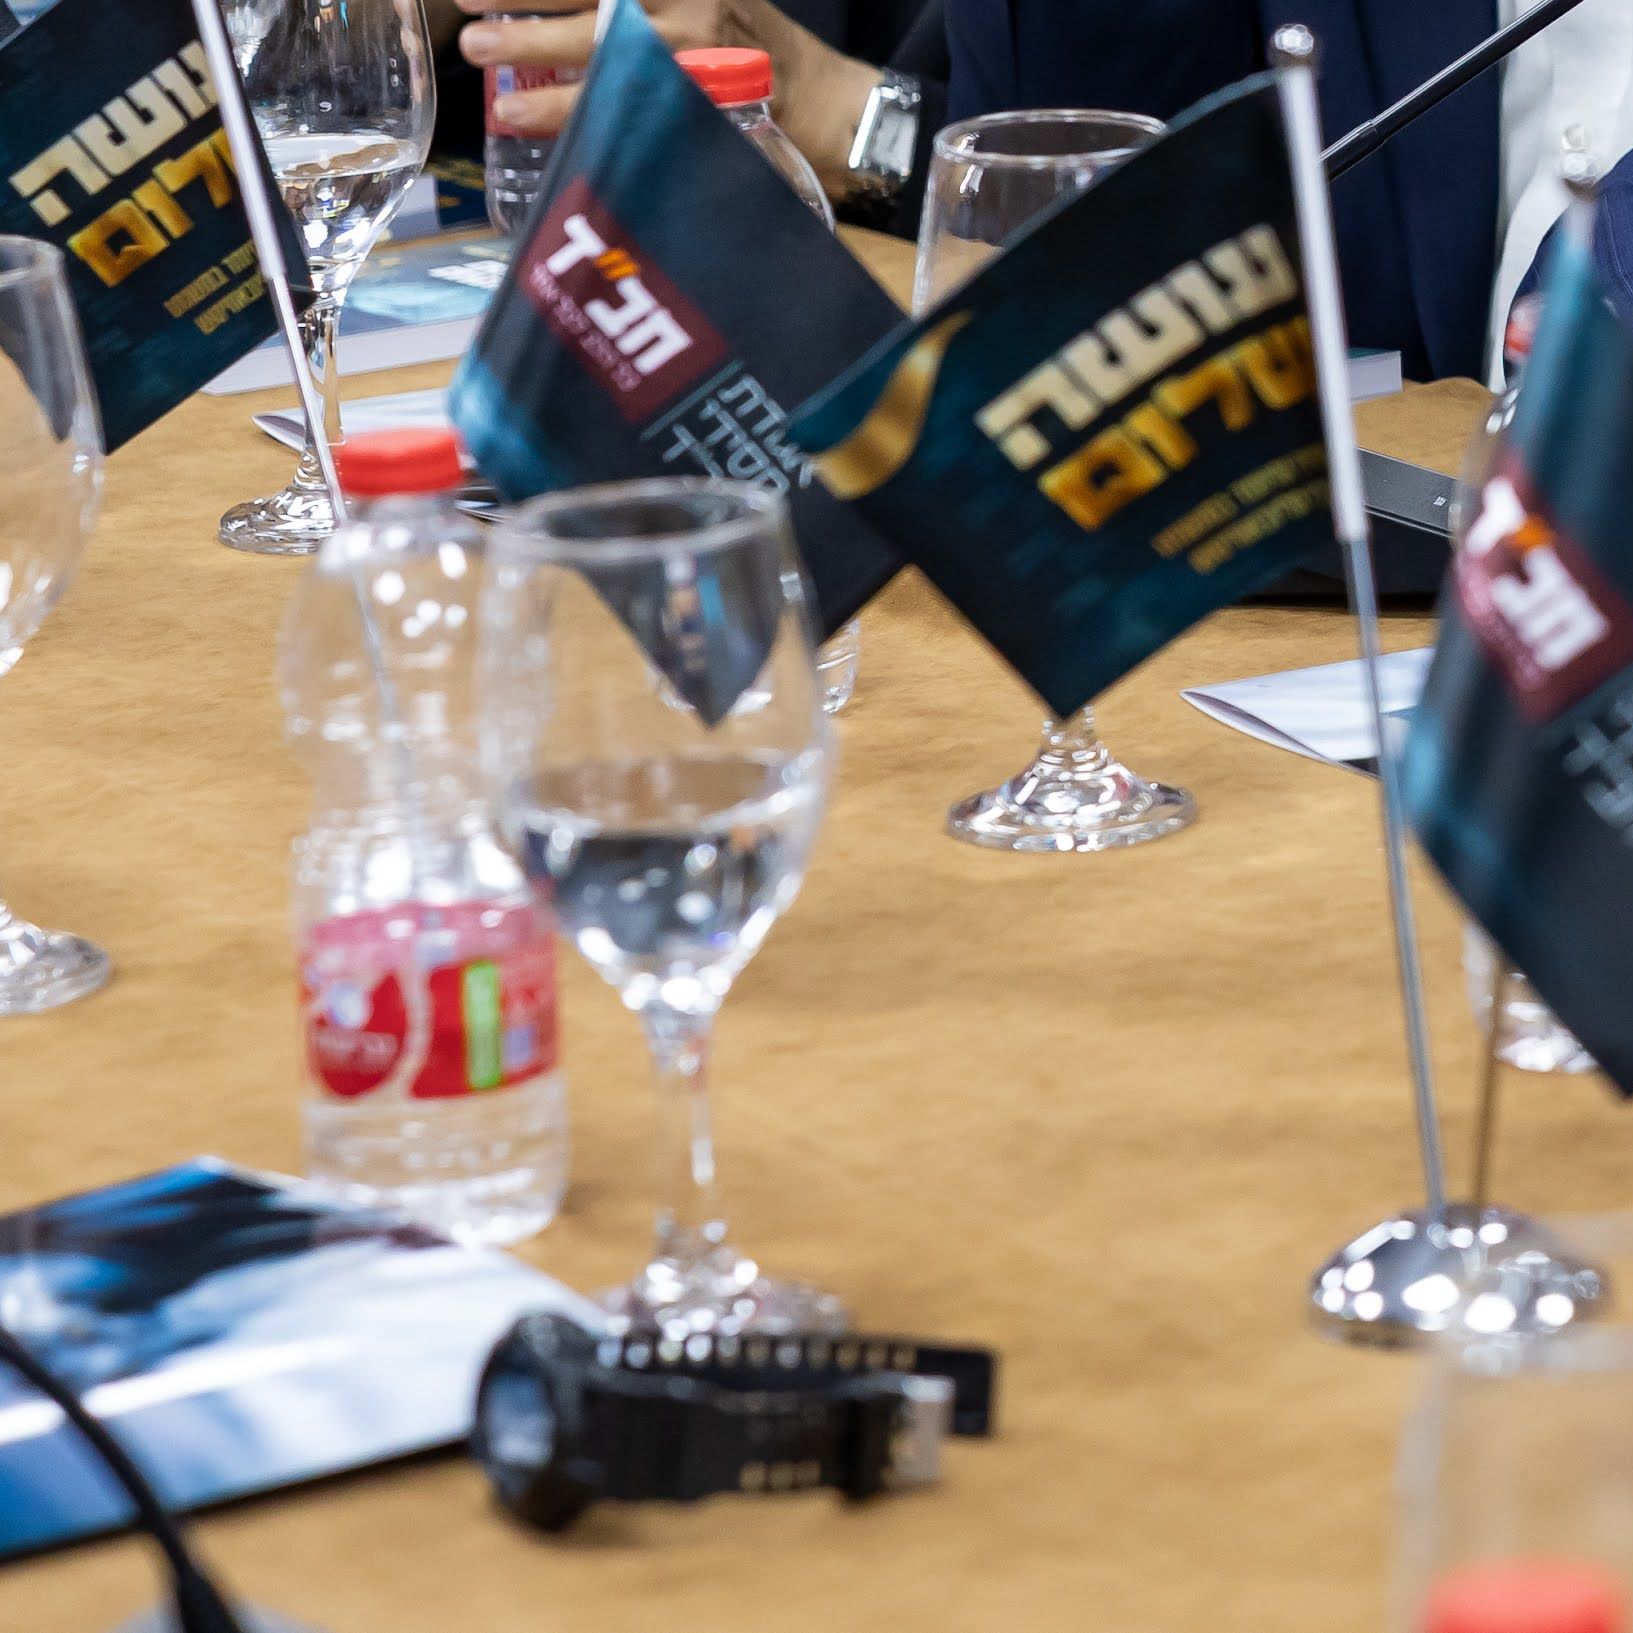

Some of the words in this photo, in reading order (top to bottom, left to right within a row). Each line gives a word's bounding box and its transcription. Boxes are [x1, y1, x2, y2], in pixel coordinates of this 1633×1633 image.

[70, 132, 235, 286] לום
[547, 214, 692, 374] חב"ד
[977, 225, 1298, 468] עושה
